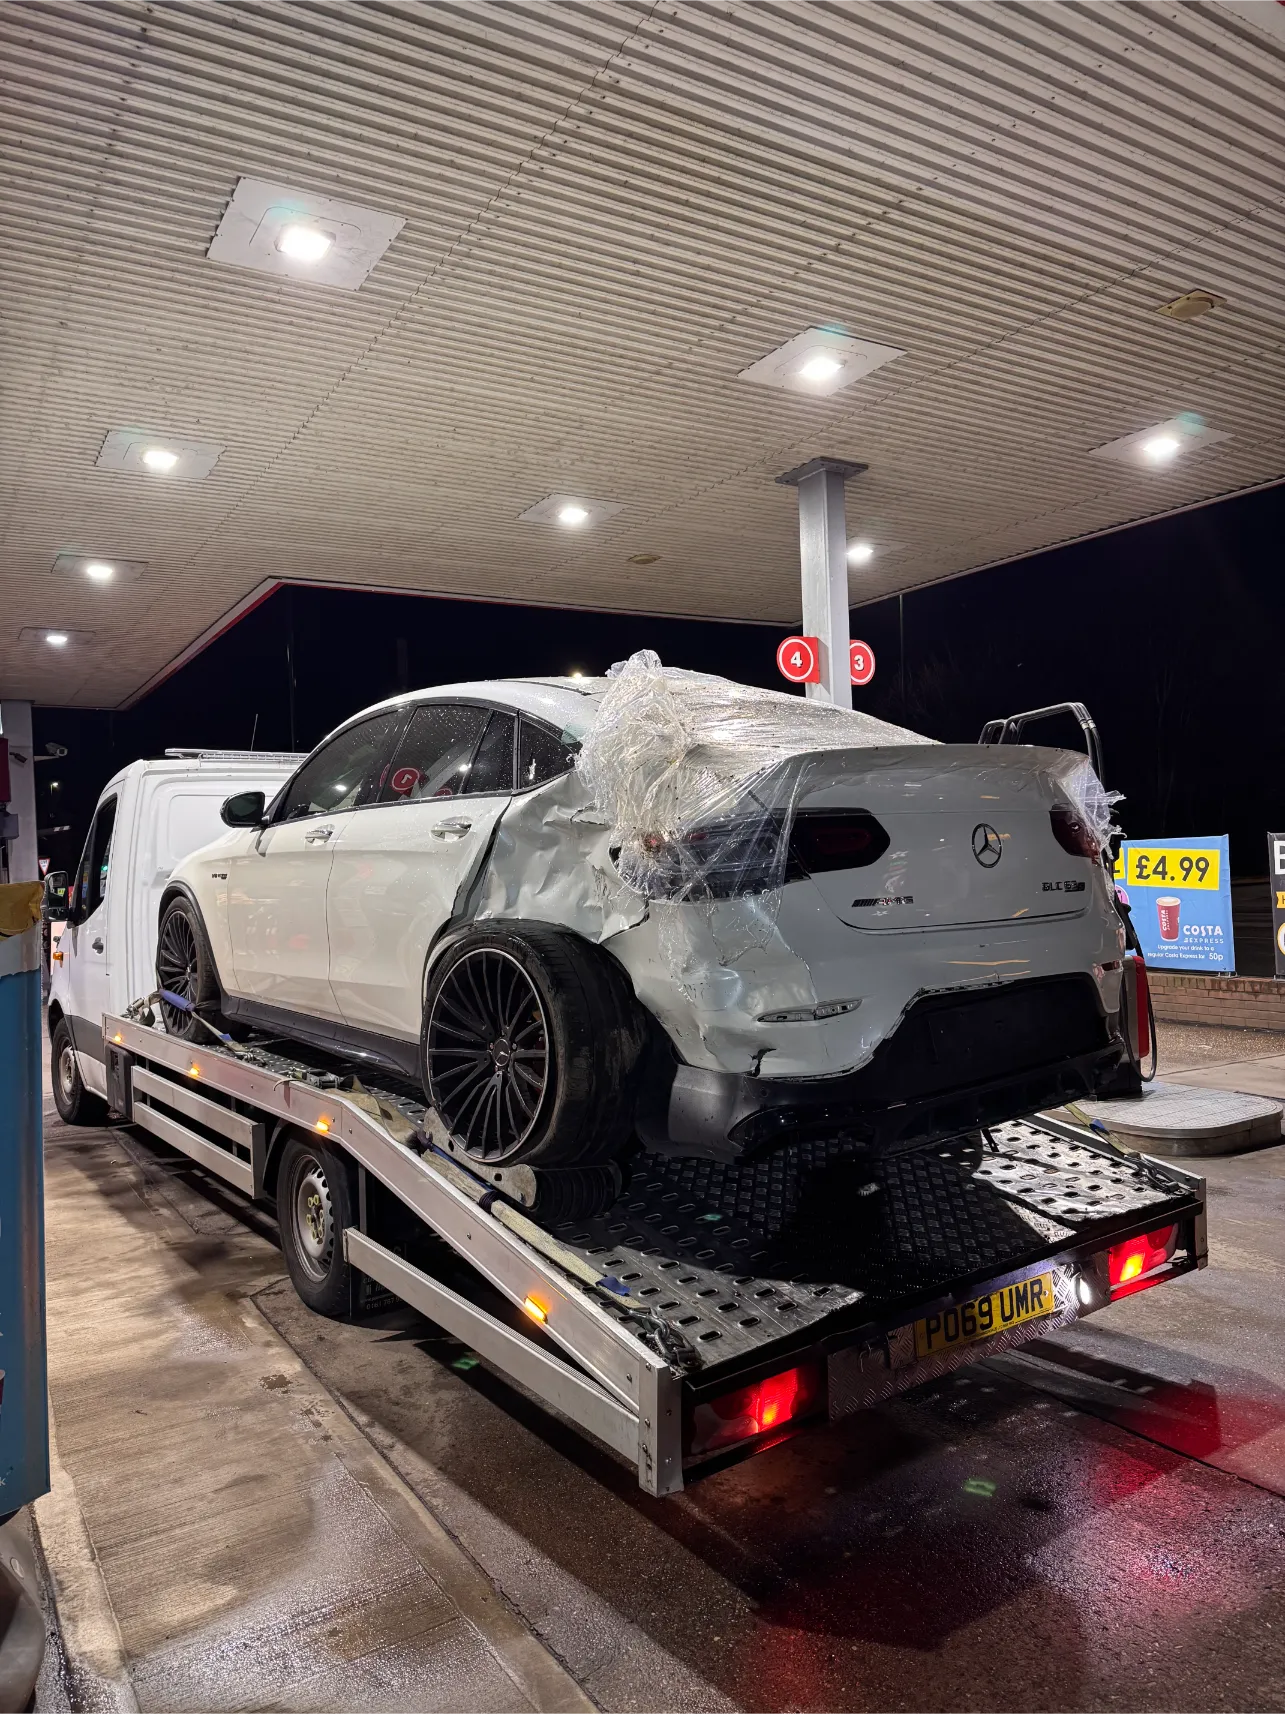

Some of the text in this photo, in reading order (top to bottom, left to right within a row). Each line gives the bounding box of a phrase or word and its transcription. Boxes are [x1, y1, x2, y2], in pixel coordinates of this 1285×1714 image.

[790, 651, 803, 668] 4
[853, 654, 865, 671] 3
[1135, 854, 1210, 883] £4.99
[1182, 924, 1224, 937] COSTA
[1208, 952, 1224, 962] 50p
[925, 1278, 1044, 1350] PO69 UMR
